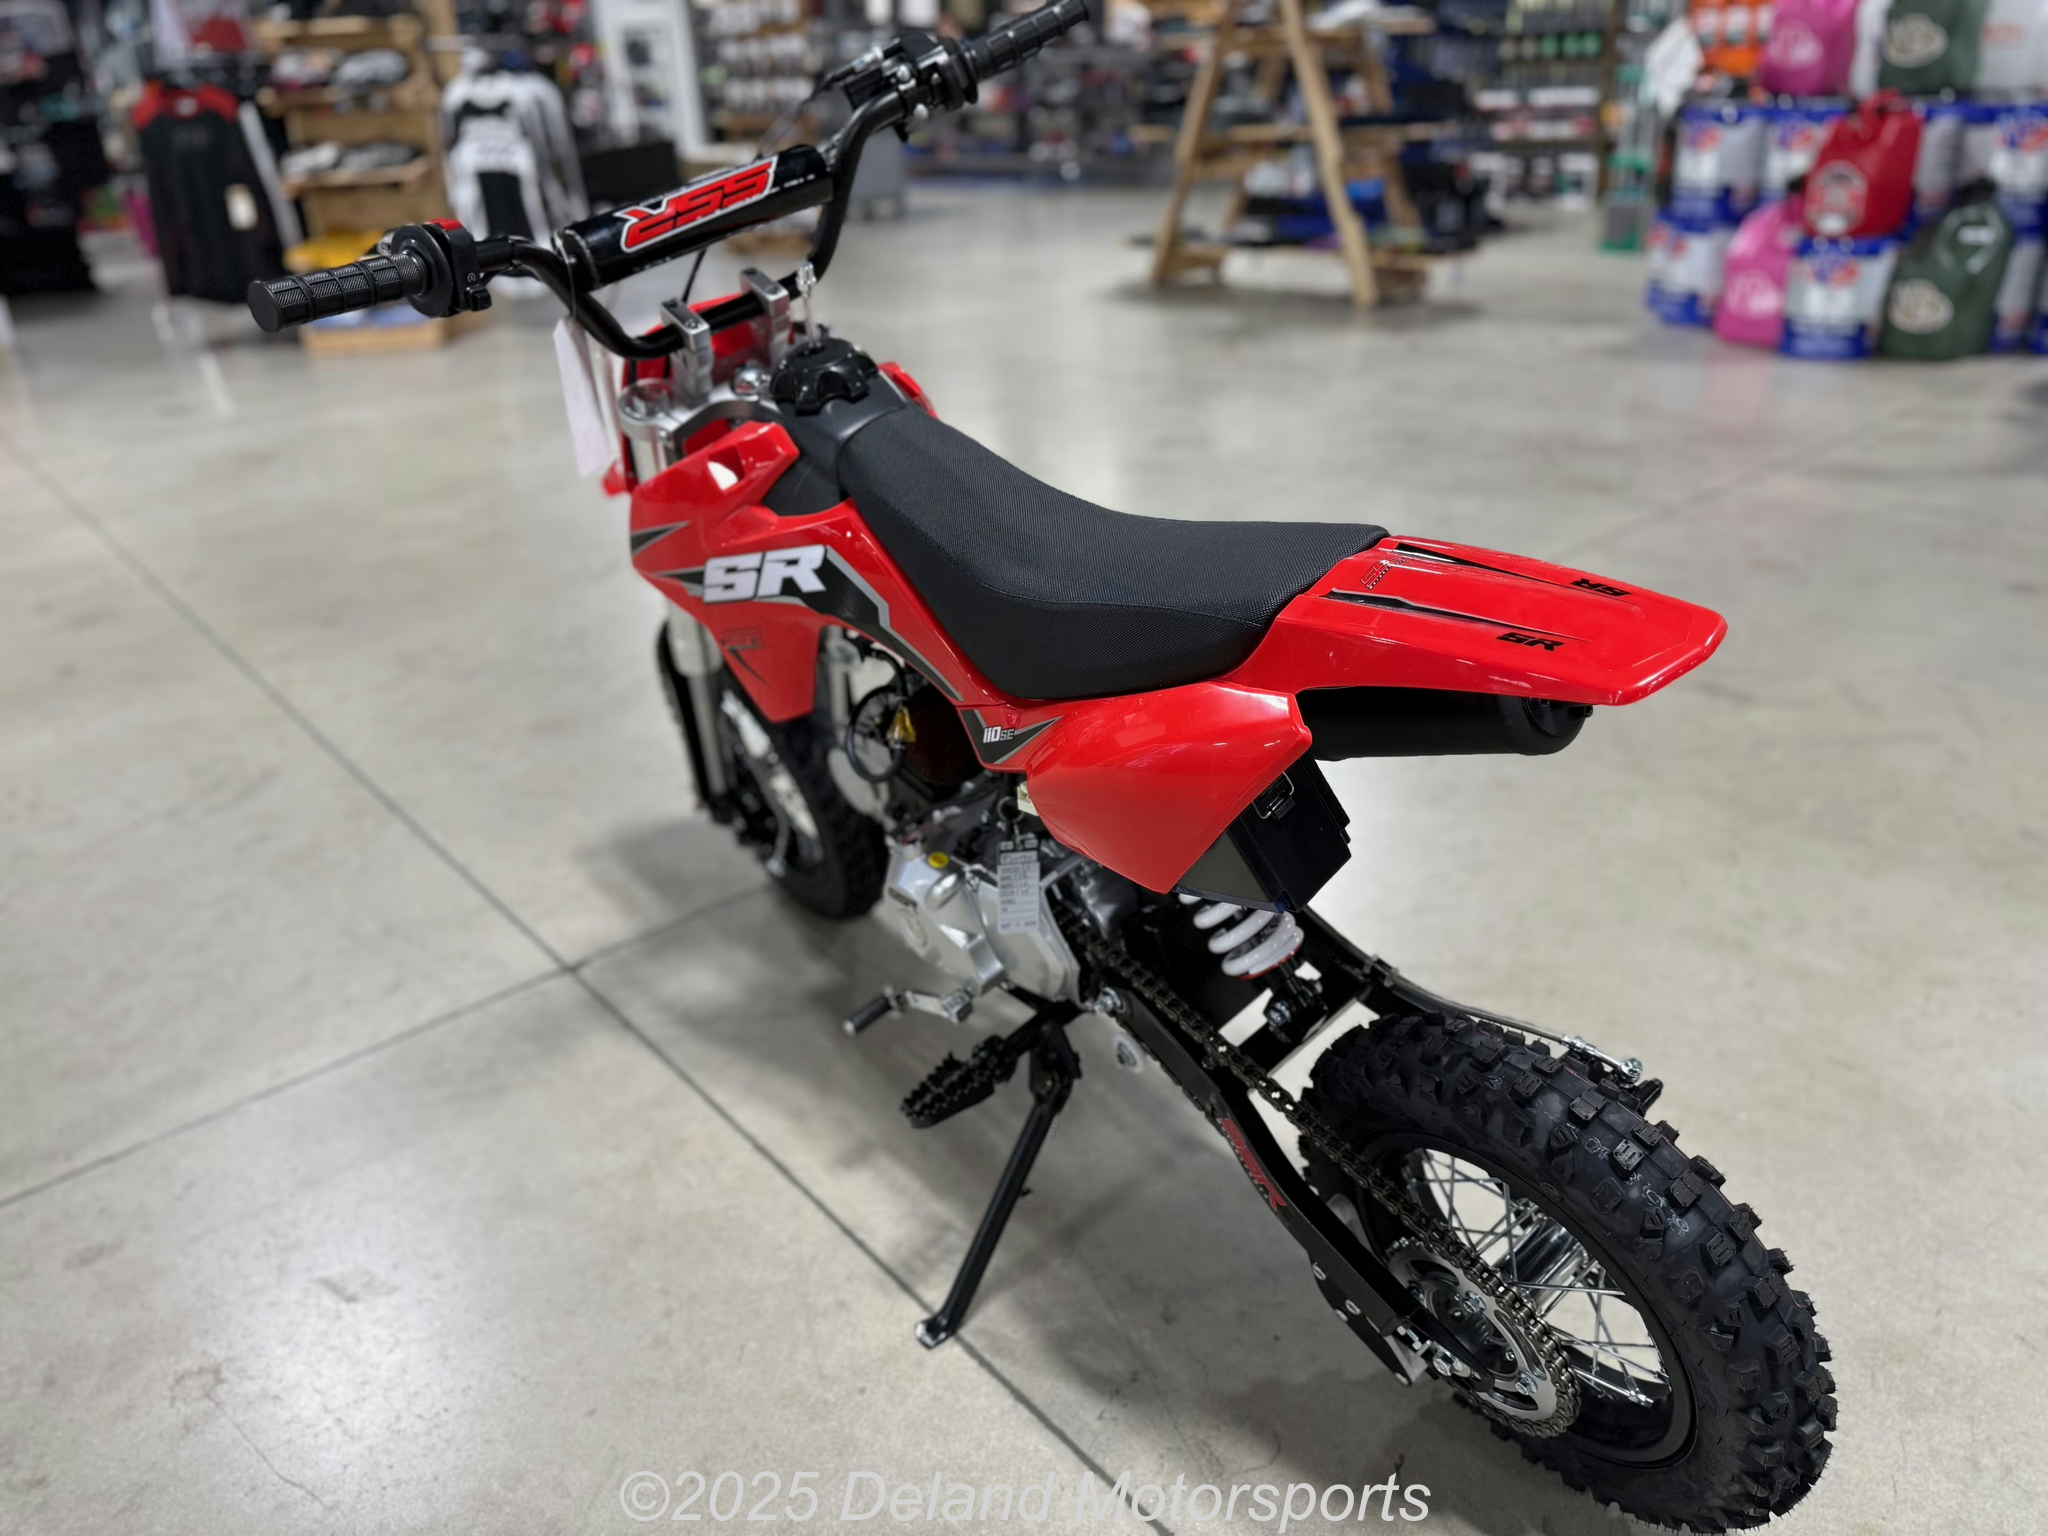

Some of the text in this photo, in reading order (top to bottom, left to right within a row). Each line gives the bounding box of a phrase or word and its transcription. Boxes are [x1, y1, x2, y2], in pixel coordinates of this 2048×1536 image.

[617, 157, 777, 251] SSR
[703, 543, 827, 604] SR
[1570, 578, 1633, 597] SR
[1496, 632, 1565, 651] SR
[1220, 1118, 1287, 1211] SSR
